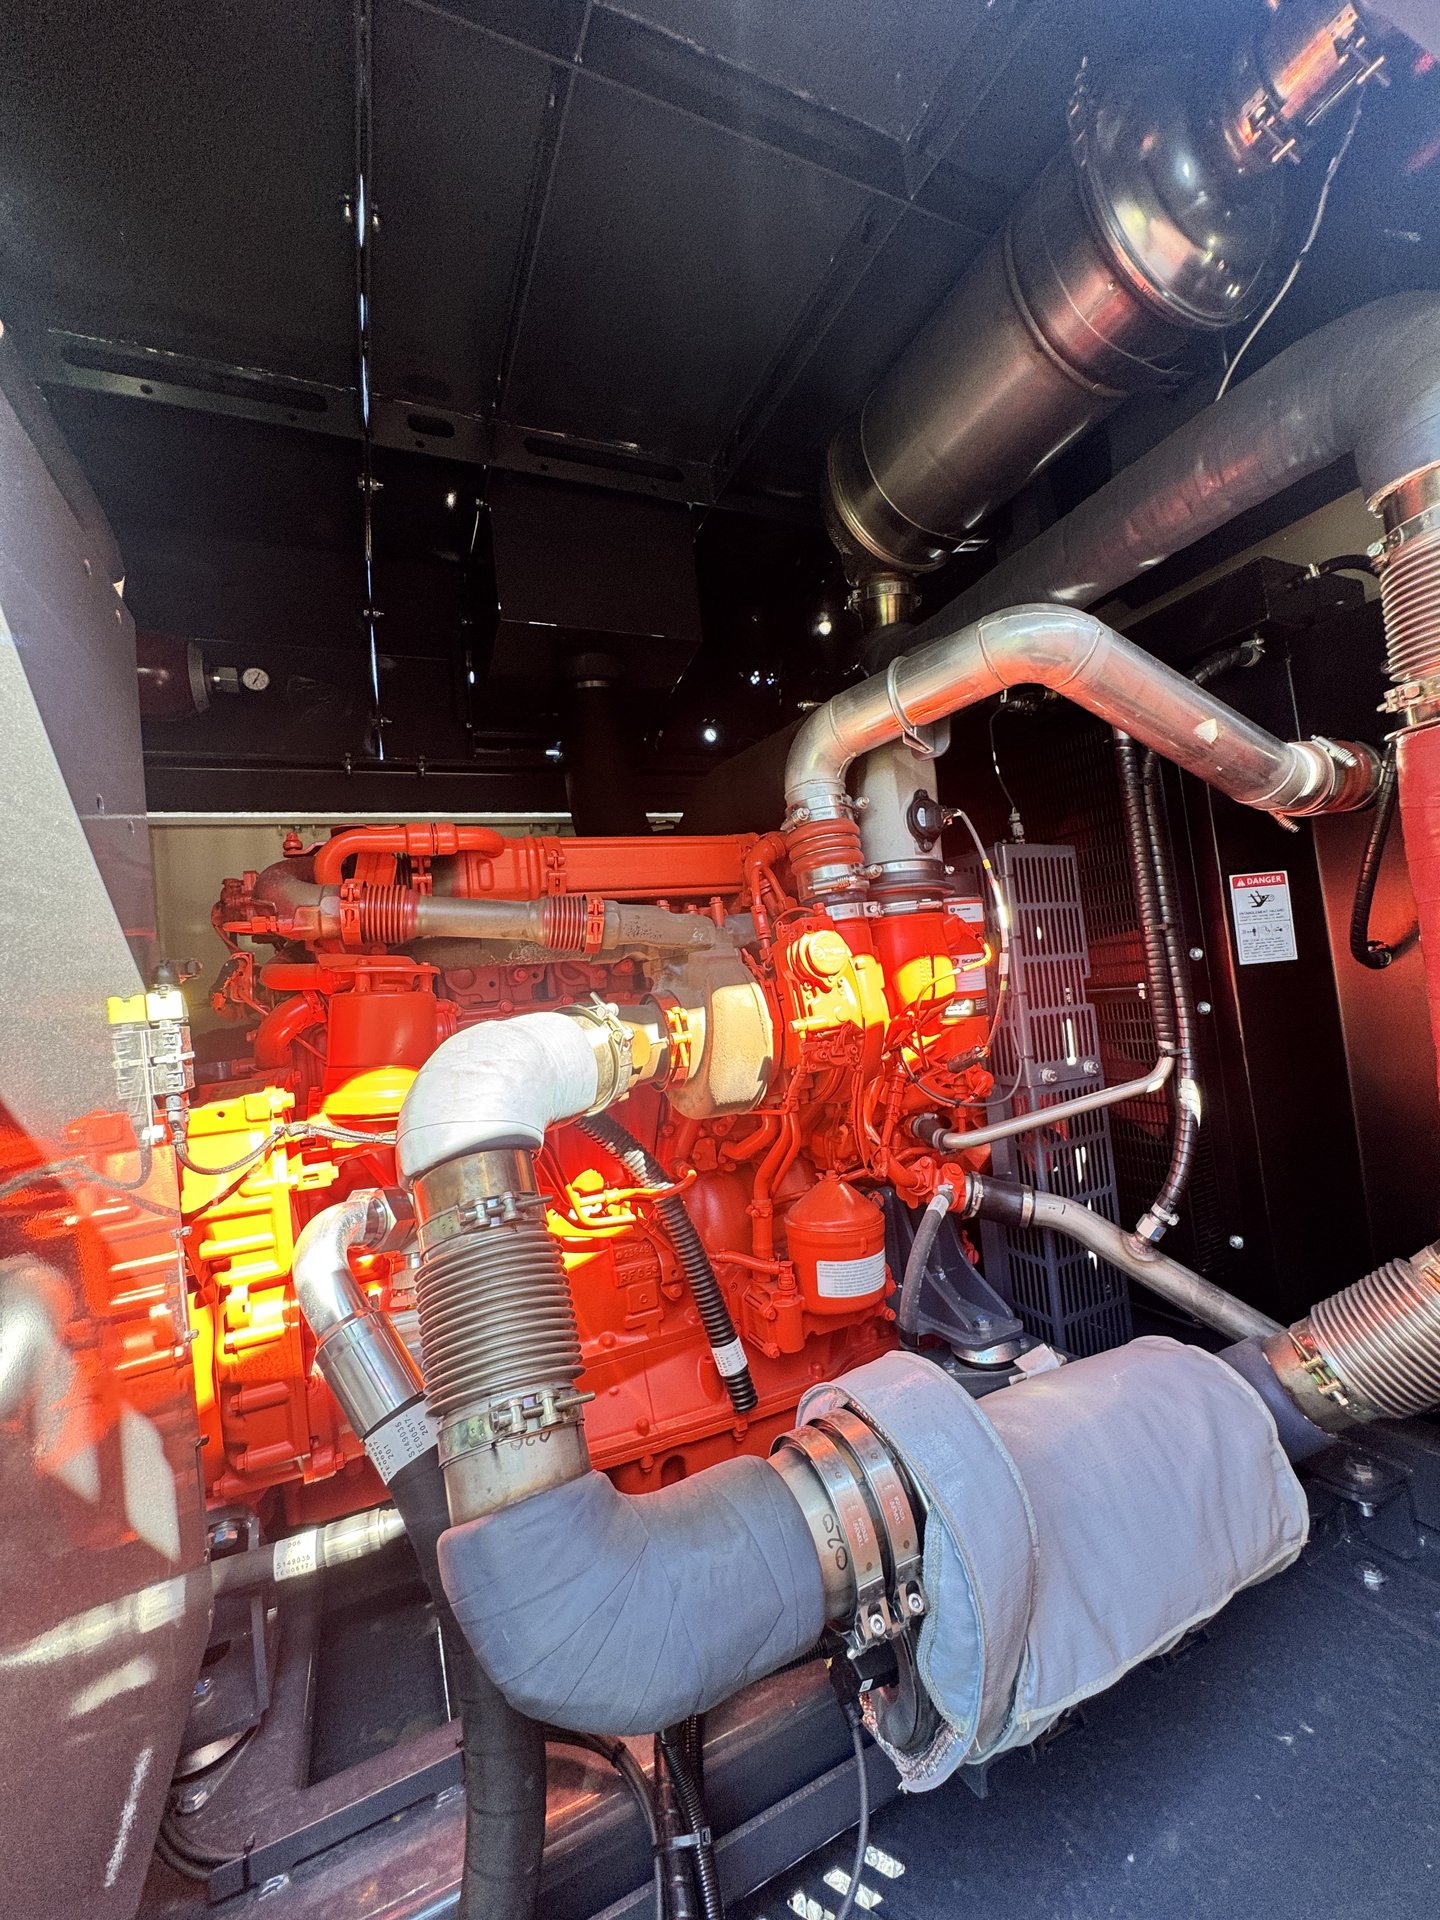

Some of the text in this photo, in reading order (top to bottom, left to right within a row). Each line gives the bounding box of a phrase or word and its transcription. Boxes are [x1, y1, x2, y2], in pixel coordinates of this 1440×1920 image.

[1246, 875, 1282, 885] DANGER
[405, 1414, 425, 1453] TE00517-
[417, 1420, 429, 1436] 201
[395, 1421, 415, 1458] S149035
[384, 1444, 394, 1460] 201
